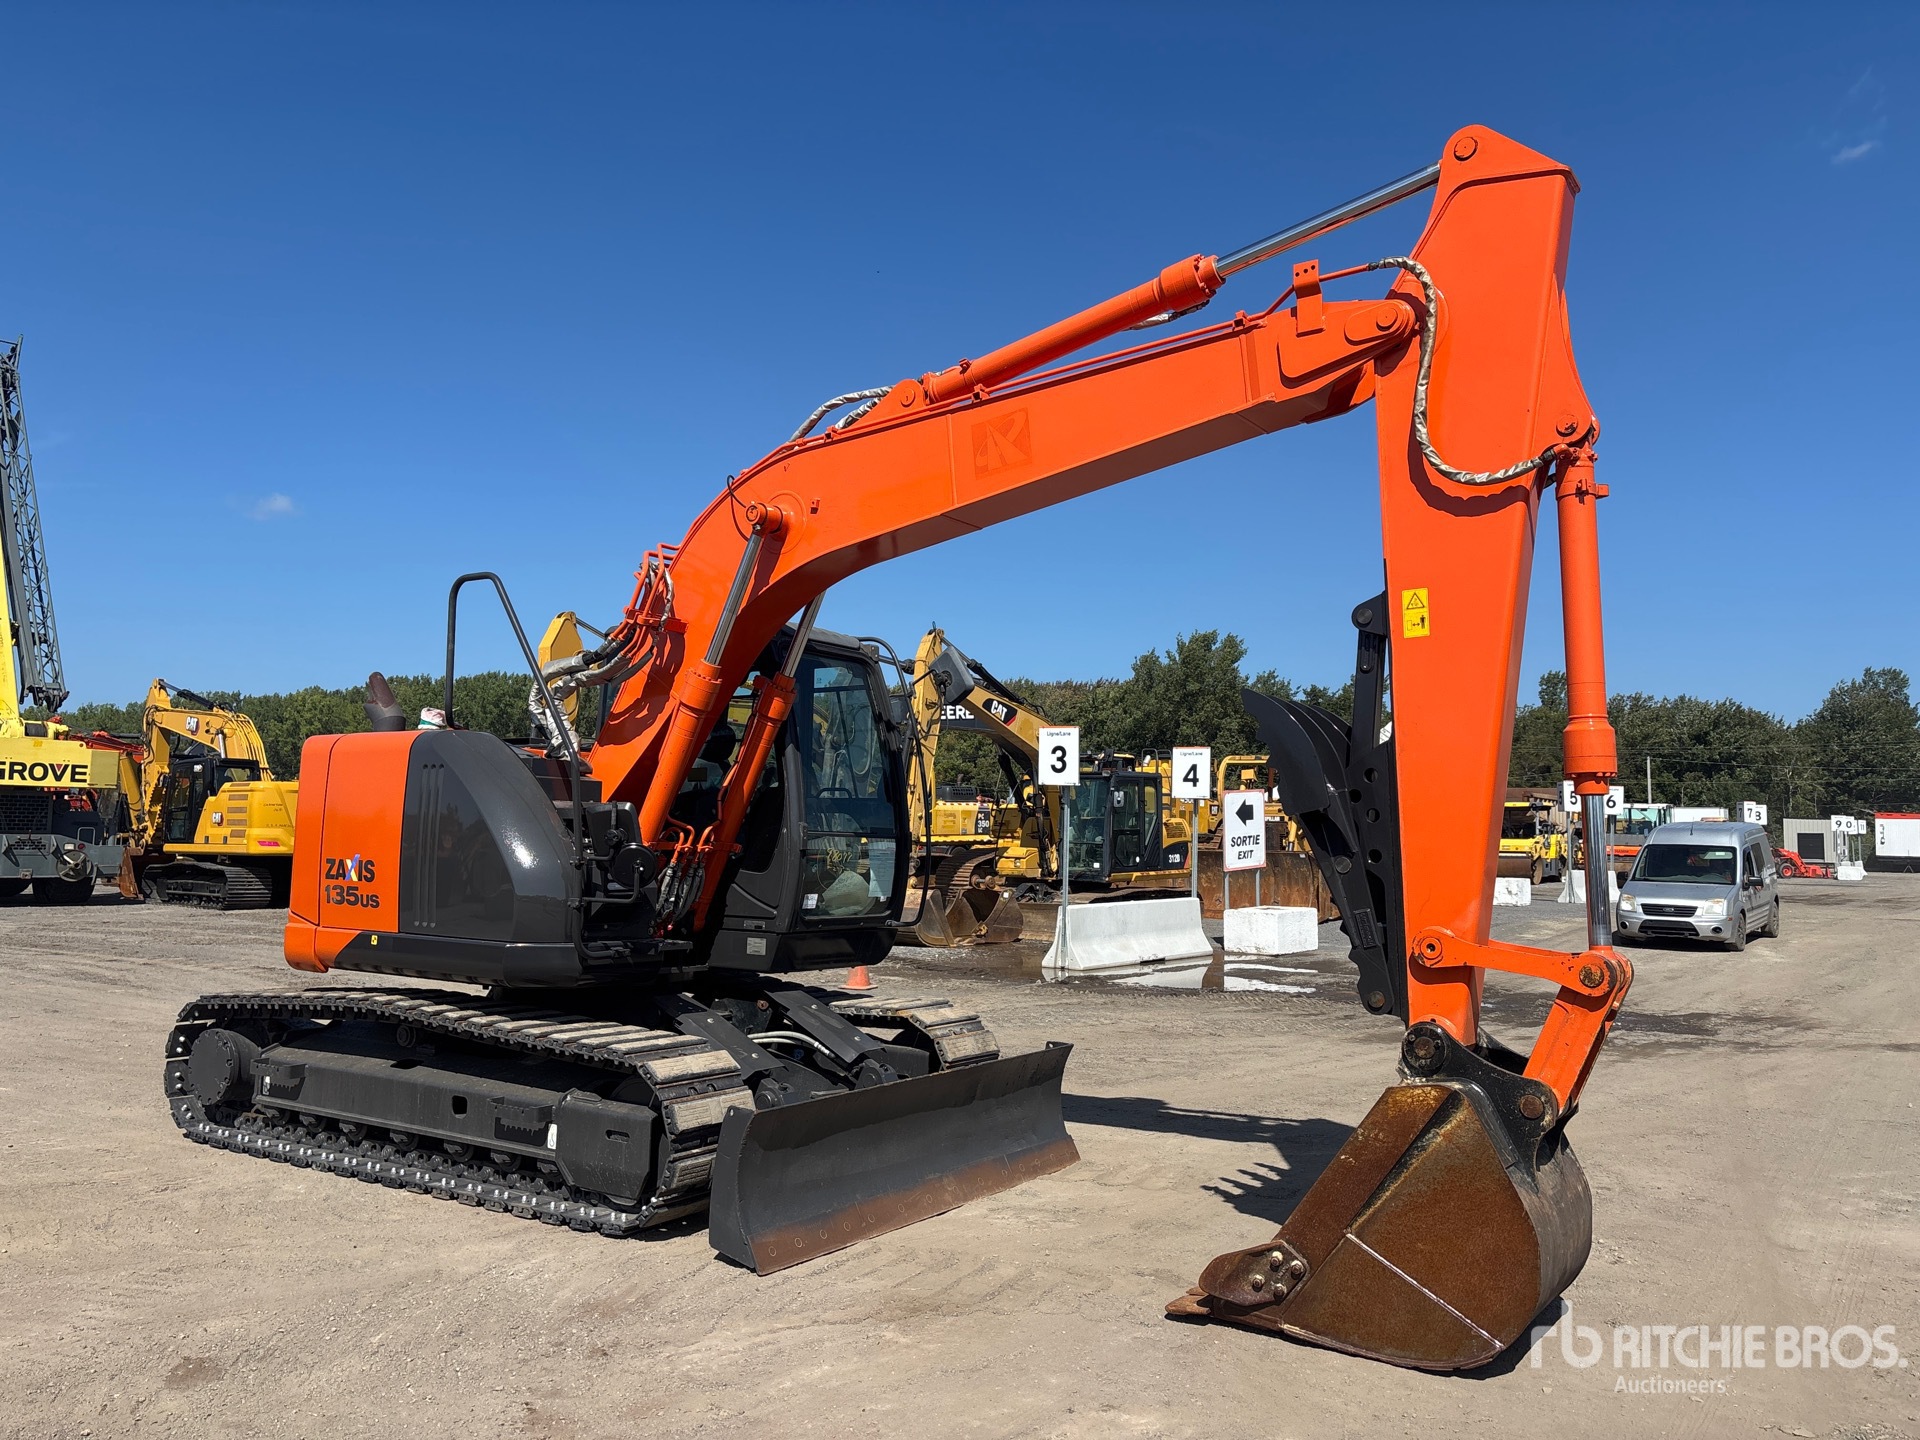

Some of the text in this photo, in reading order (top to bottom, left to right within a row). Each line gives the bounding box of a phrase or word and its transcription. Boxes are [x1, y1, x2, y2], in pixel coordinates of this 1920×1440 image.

[990, 700, 1008, 721] CAT
[186, 716, 198, 731] CAT
[1050, 745, 1067, 773] 3
[1182, 763, 1200, 787] 4
[1569, 791, 1578, 805] 5
[1606, 795, 1616, 808] 6
[1747, 808, 1753, 818] 7
[977, 820, 990, 828] 350
[1835, 820, 1842, 828] 9
[1230, 834, 1261, 848] SORTIE
[1237, 849, 1254, 860] EXIT
[325, 853, 376, 883] ZAXIS
